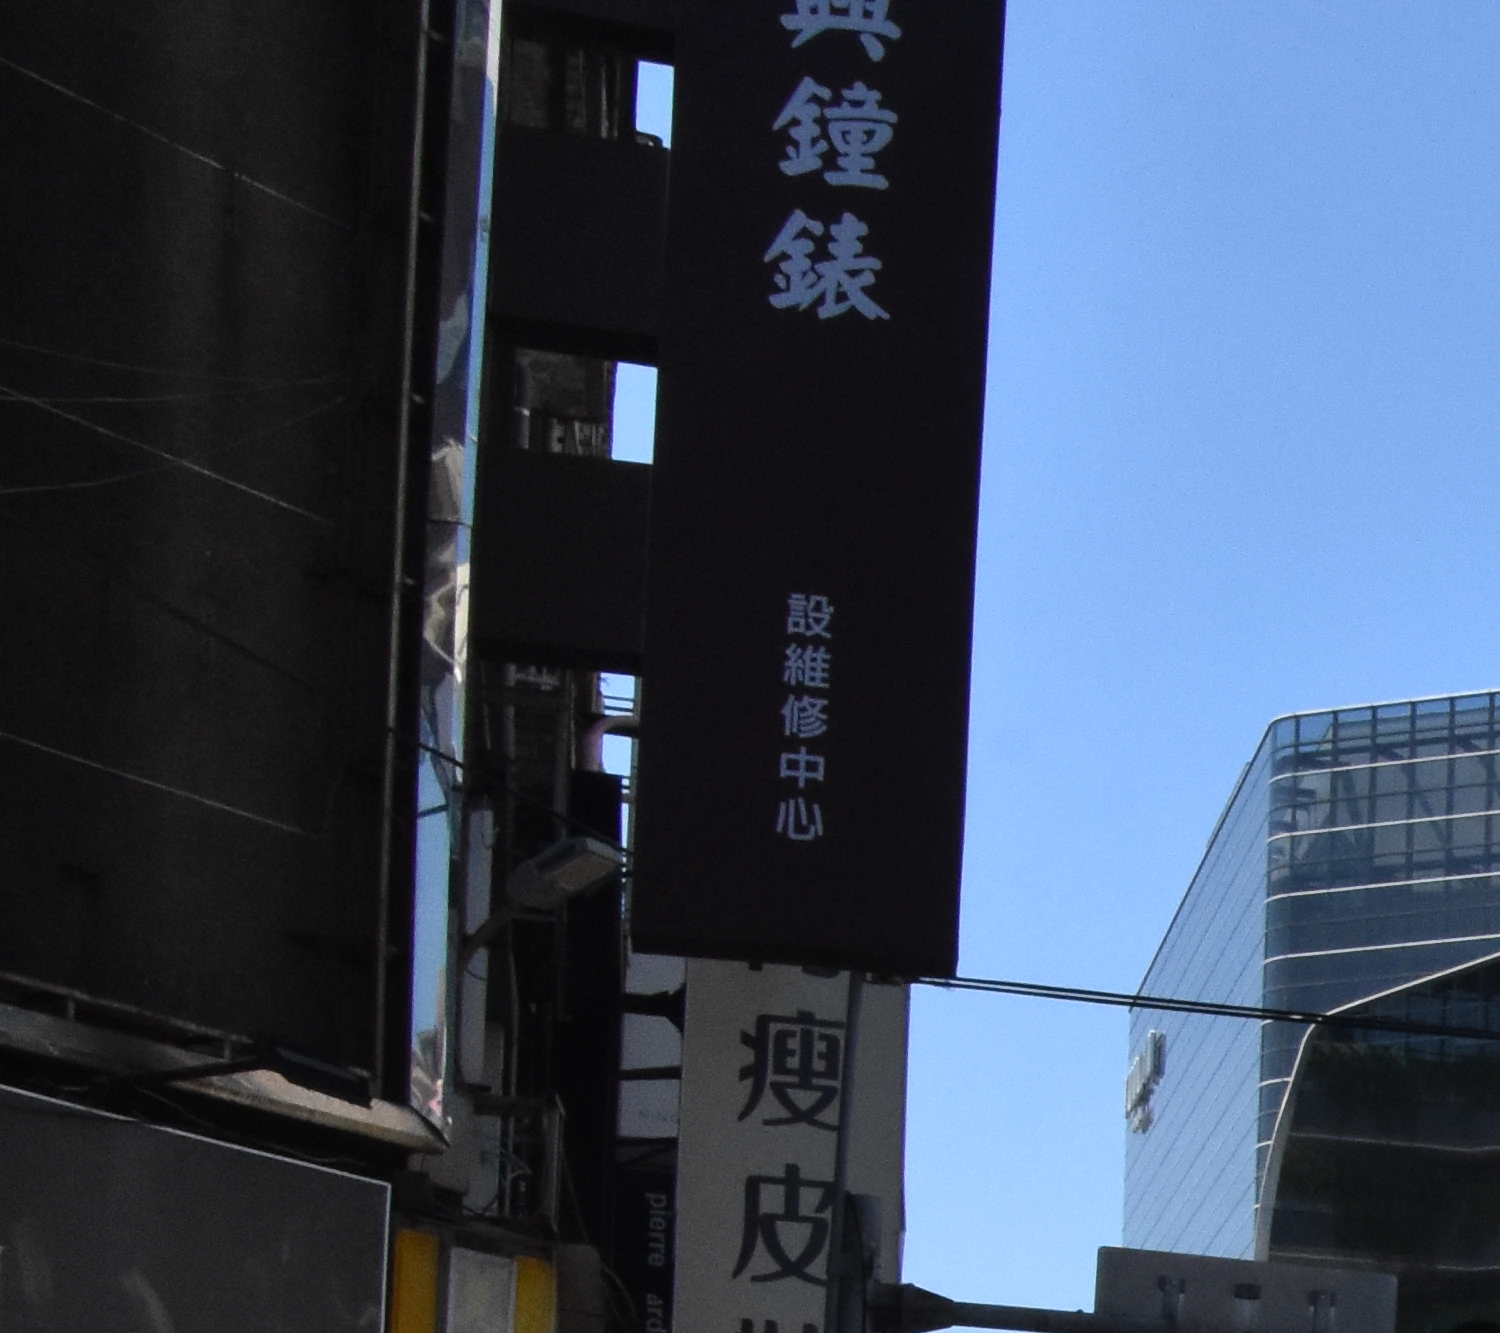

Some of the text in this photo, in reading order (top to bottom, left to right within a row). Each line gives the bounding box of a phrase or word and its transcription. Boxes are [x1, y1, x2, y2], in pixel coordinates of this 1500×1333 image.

[775, 591, 836, 843] 設維修中心
[644, 1192, 670, 1268] pierre
